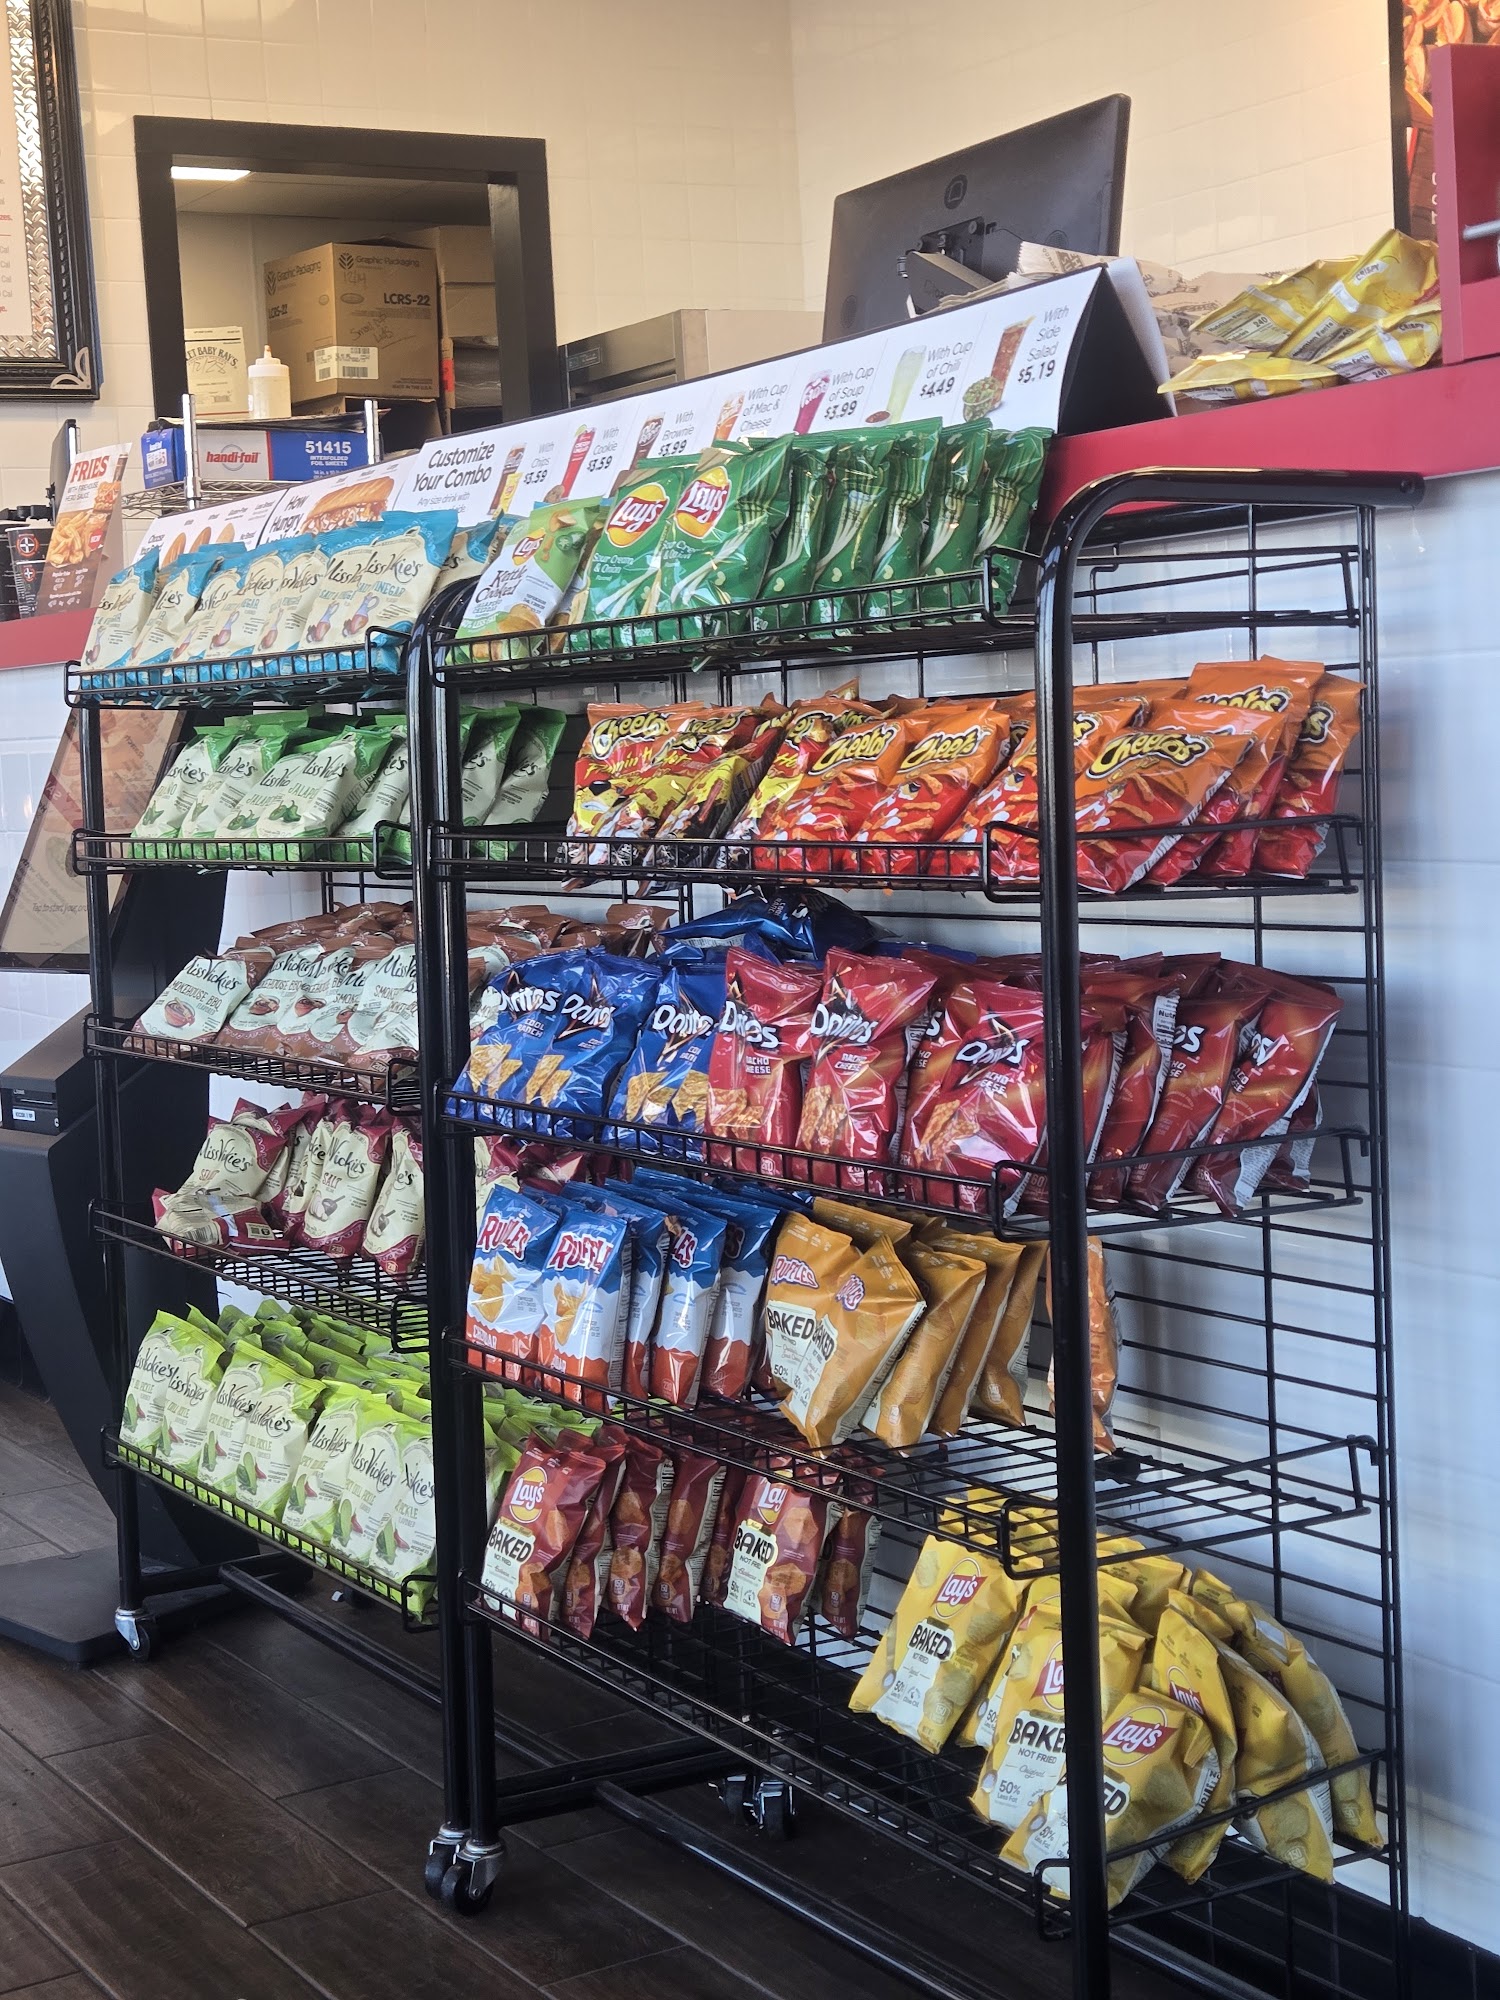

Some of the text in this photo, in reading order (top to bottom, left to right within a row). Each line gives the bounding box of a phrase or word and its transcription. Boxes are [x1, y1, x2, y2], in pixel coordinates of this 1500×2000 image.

[356, 256, 420, 267] Graphic Packaging
[1356, 263, 1380, 281] CRISPY
[384, 293, 431, 306] LCRS-22
[268, 304, 288, 319] LCRS-22
[1044, 305, 1069, 324] With
[1208, 307, 1250, 333] Nutrition Facts
[1253, 316, 1268, 330] 240
[1316, 321, 1333, 338] Facts
[1036, 324, 1061, 342] Side
[197, 346, 217, 356] BABY
[927, 341, 973, 363] With Cup
[1028, 342, 1059, 363] Salad
[1352, 353, 1369, 365] Facts
[832, 366, 875, 386] With Cup
[926, 358, 962, 379] of Chili
[1018, 360, 1056, 384] $5.19
[1372, 368, 1387, 379] 240
[750, 386, 769, 400] With
[770, 384, 788, 398] Cup
[829, 387, 841, 402] of
[841, 383, 865, 400] Soup
[920, 376, 956, 398] $4.49
[742, 399, 780, 417] of Mac &
[824, 400, 857, 420] $3.99
[675, 411, 694, 425] With
[740, 418, 772, 433] Cheese
[602, 428, 619, 440] With
[662, 426, 695, 440] Brownie
[305, 440, 352, 455] 51415
[428, 441, 495, 469] Customize
[539, 441, 554, 454] With
[593, 444, 618, 456] Cookie
[658, 440, 688, 457] $3.99
[206, 452, 260, 464] handi-foil
[531, 457, 551, 469] Chips
[587, 456, 613, 472] $3.59
[70, 455, 110, 483] FRIES
[524, 469, 548, 485] $3.59
[412, 466, 493, 492] Your Combo
[284, 494, 309, 511] How
[417, 491, 470, 506] Any size drink with
[677, 481, 727, 523] Lay's
[271, 513, 304, 533] Hungry
[610, 498, 664, 533] Lay's
[515, 537, 543, 558] Lay's
[593, 554, 634, 565] Sour Cream
[489, 566, 527, 587] Kettle
[594, 564, 621, 574] & Onion
[373, 581, 407, 597] VINEGAR
[476, 580, 520, 603] Cooked
[593, 712, 671, 758] Cheetos
[811, 727, 892, 771] Cheetos
[900, 727, 980, 770] Cheetos
[1088, 733, 1202, 777] Cheetos
[203, 959, 241, 996] Vickie's
[206, 995, 222, 1010] BBQ
[516, 1024, 544, 1038] RANCH
[525, 1018, 545, 1031] COOL
[810, 1004, 879, 1043] Doritos
[322, 1172, 342, 1189] SALT
[774, 1256, 819, 1288] RUFFLES
[766, 1307, 814, 1340] BAKED
[812, 1324, 835, 1361] BAKED
[774, 1365, 789, 1376] 50%
[366, 1447, 397, 1493] Vickie's
[511, 1478, 544, 1511] Lay's
[758, 1478, 788, 1511] Lay
[489, 1526, 531, 1563] BAKED
[734, 1527, 775, 1565] BAKED
[739, 1555, 751, 1566] NOT
[937, 1574, 978, 1606] Lay's
[909, 1624, 953, 1660] BAKED
[1107, 1719, 1163, 1754] Lay's
[1018, 1748, 1057, 1764] NOT FRIED
[1020, 1764, 1045, 1779] Original
[999, 1780, 1021, 1796] 50%
[997, 1792, 1008, 1802] Less
[1008, 1795, 1018, 1804] Fat
[1039, 1826, 1056, 1842] 50%
